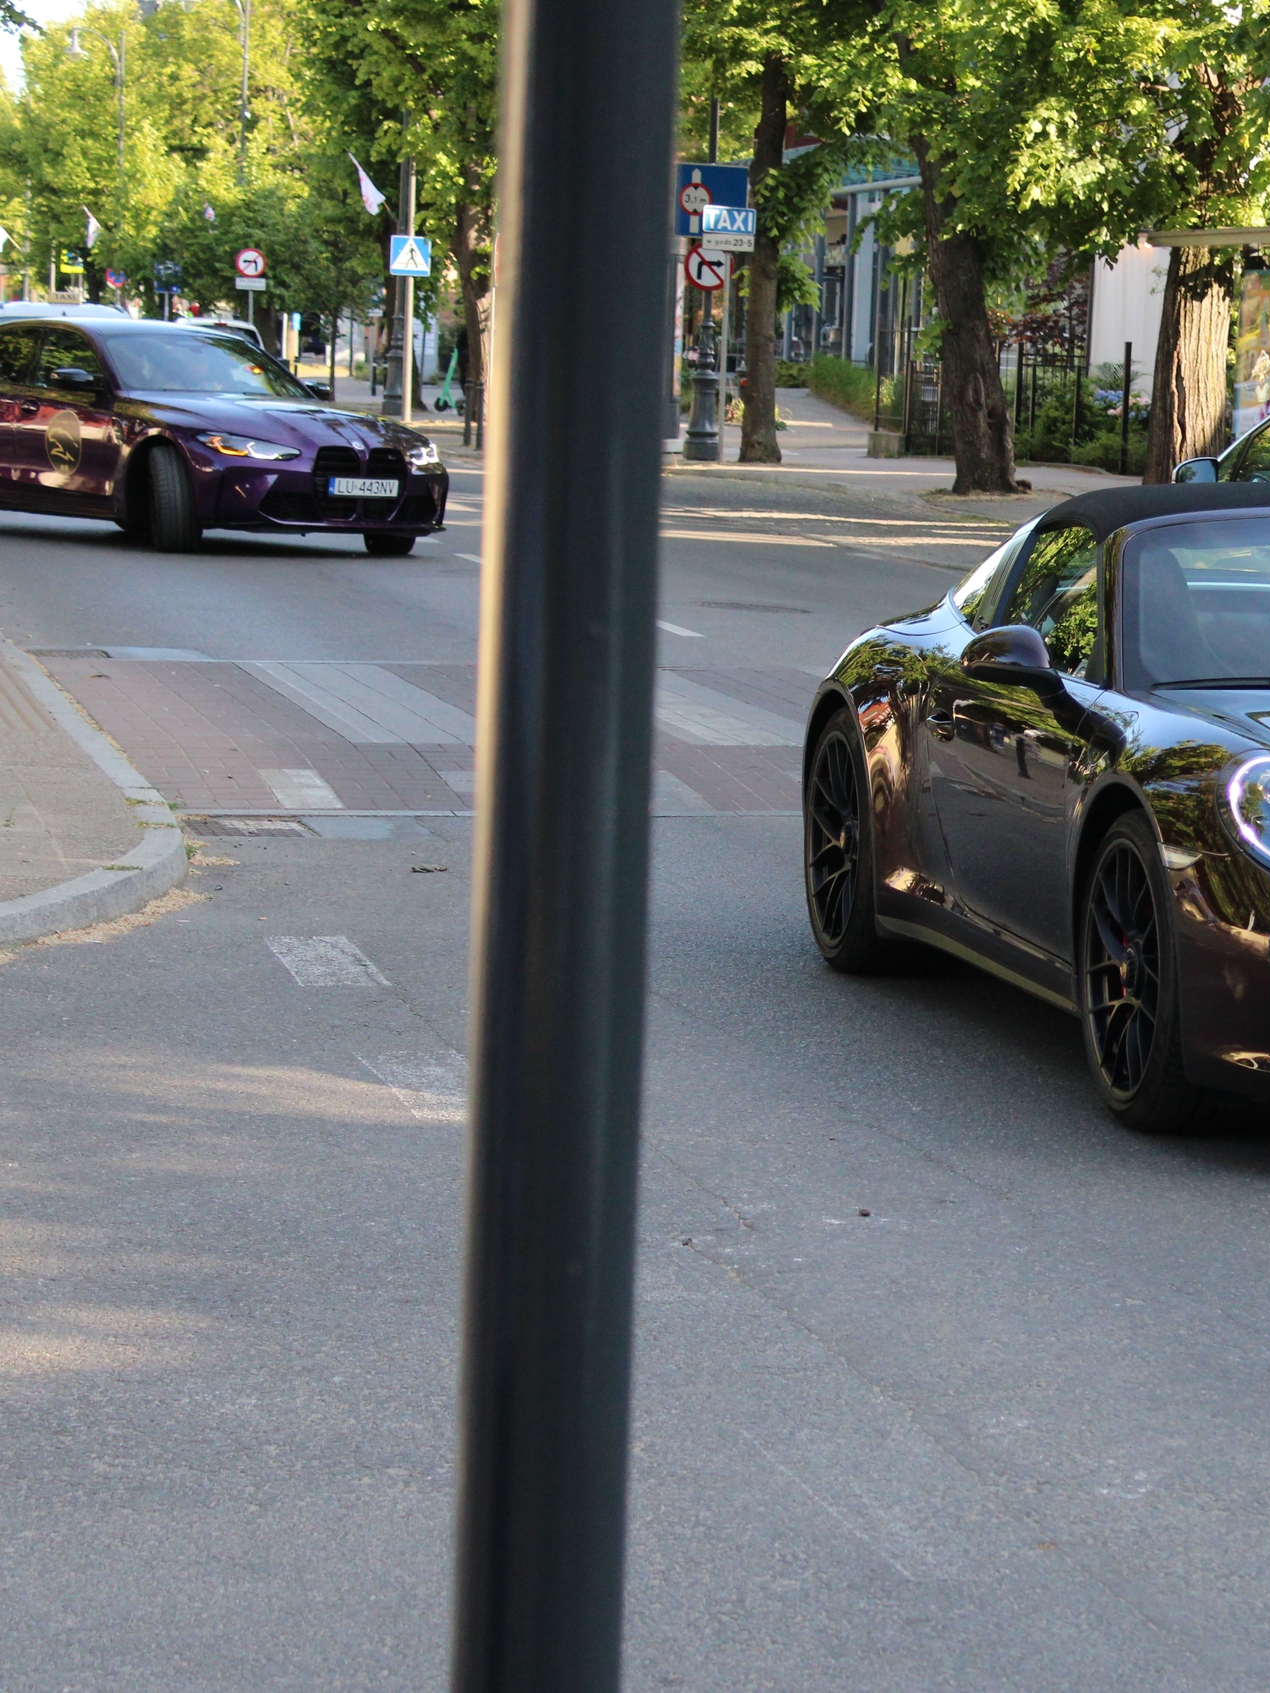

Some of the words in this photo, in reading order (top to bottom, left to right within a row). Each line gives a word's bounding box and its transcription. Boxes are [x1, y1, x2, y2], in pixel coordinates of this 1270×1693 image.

[704, 209, 753, 232] TAXI
[337, 480, 355, 494] LU
[358, 480, 395, 495] 443NV
